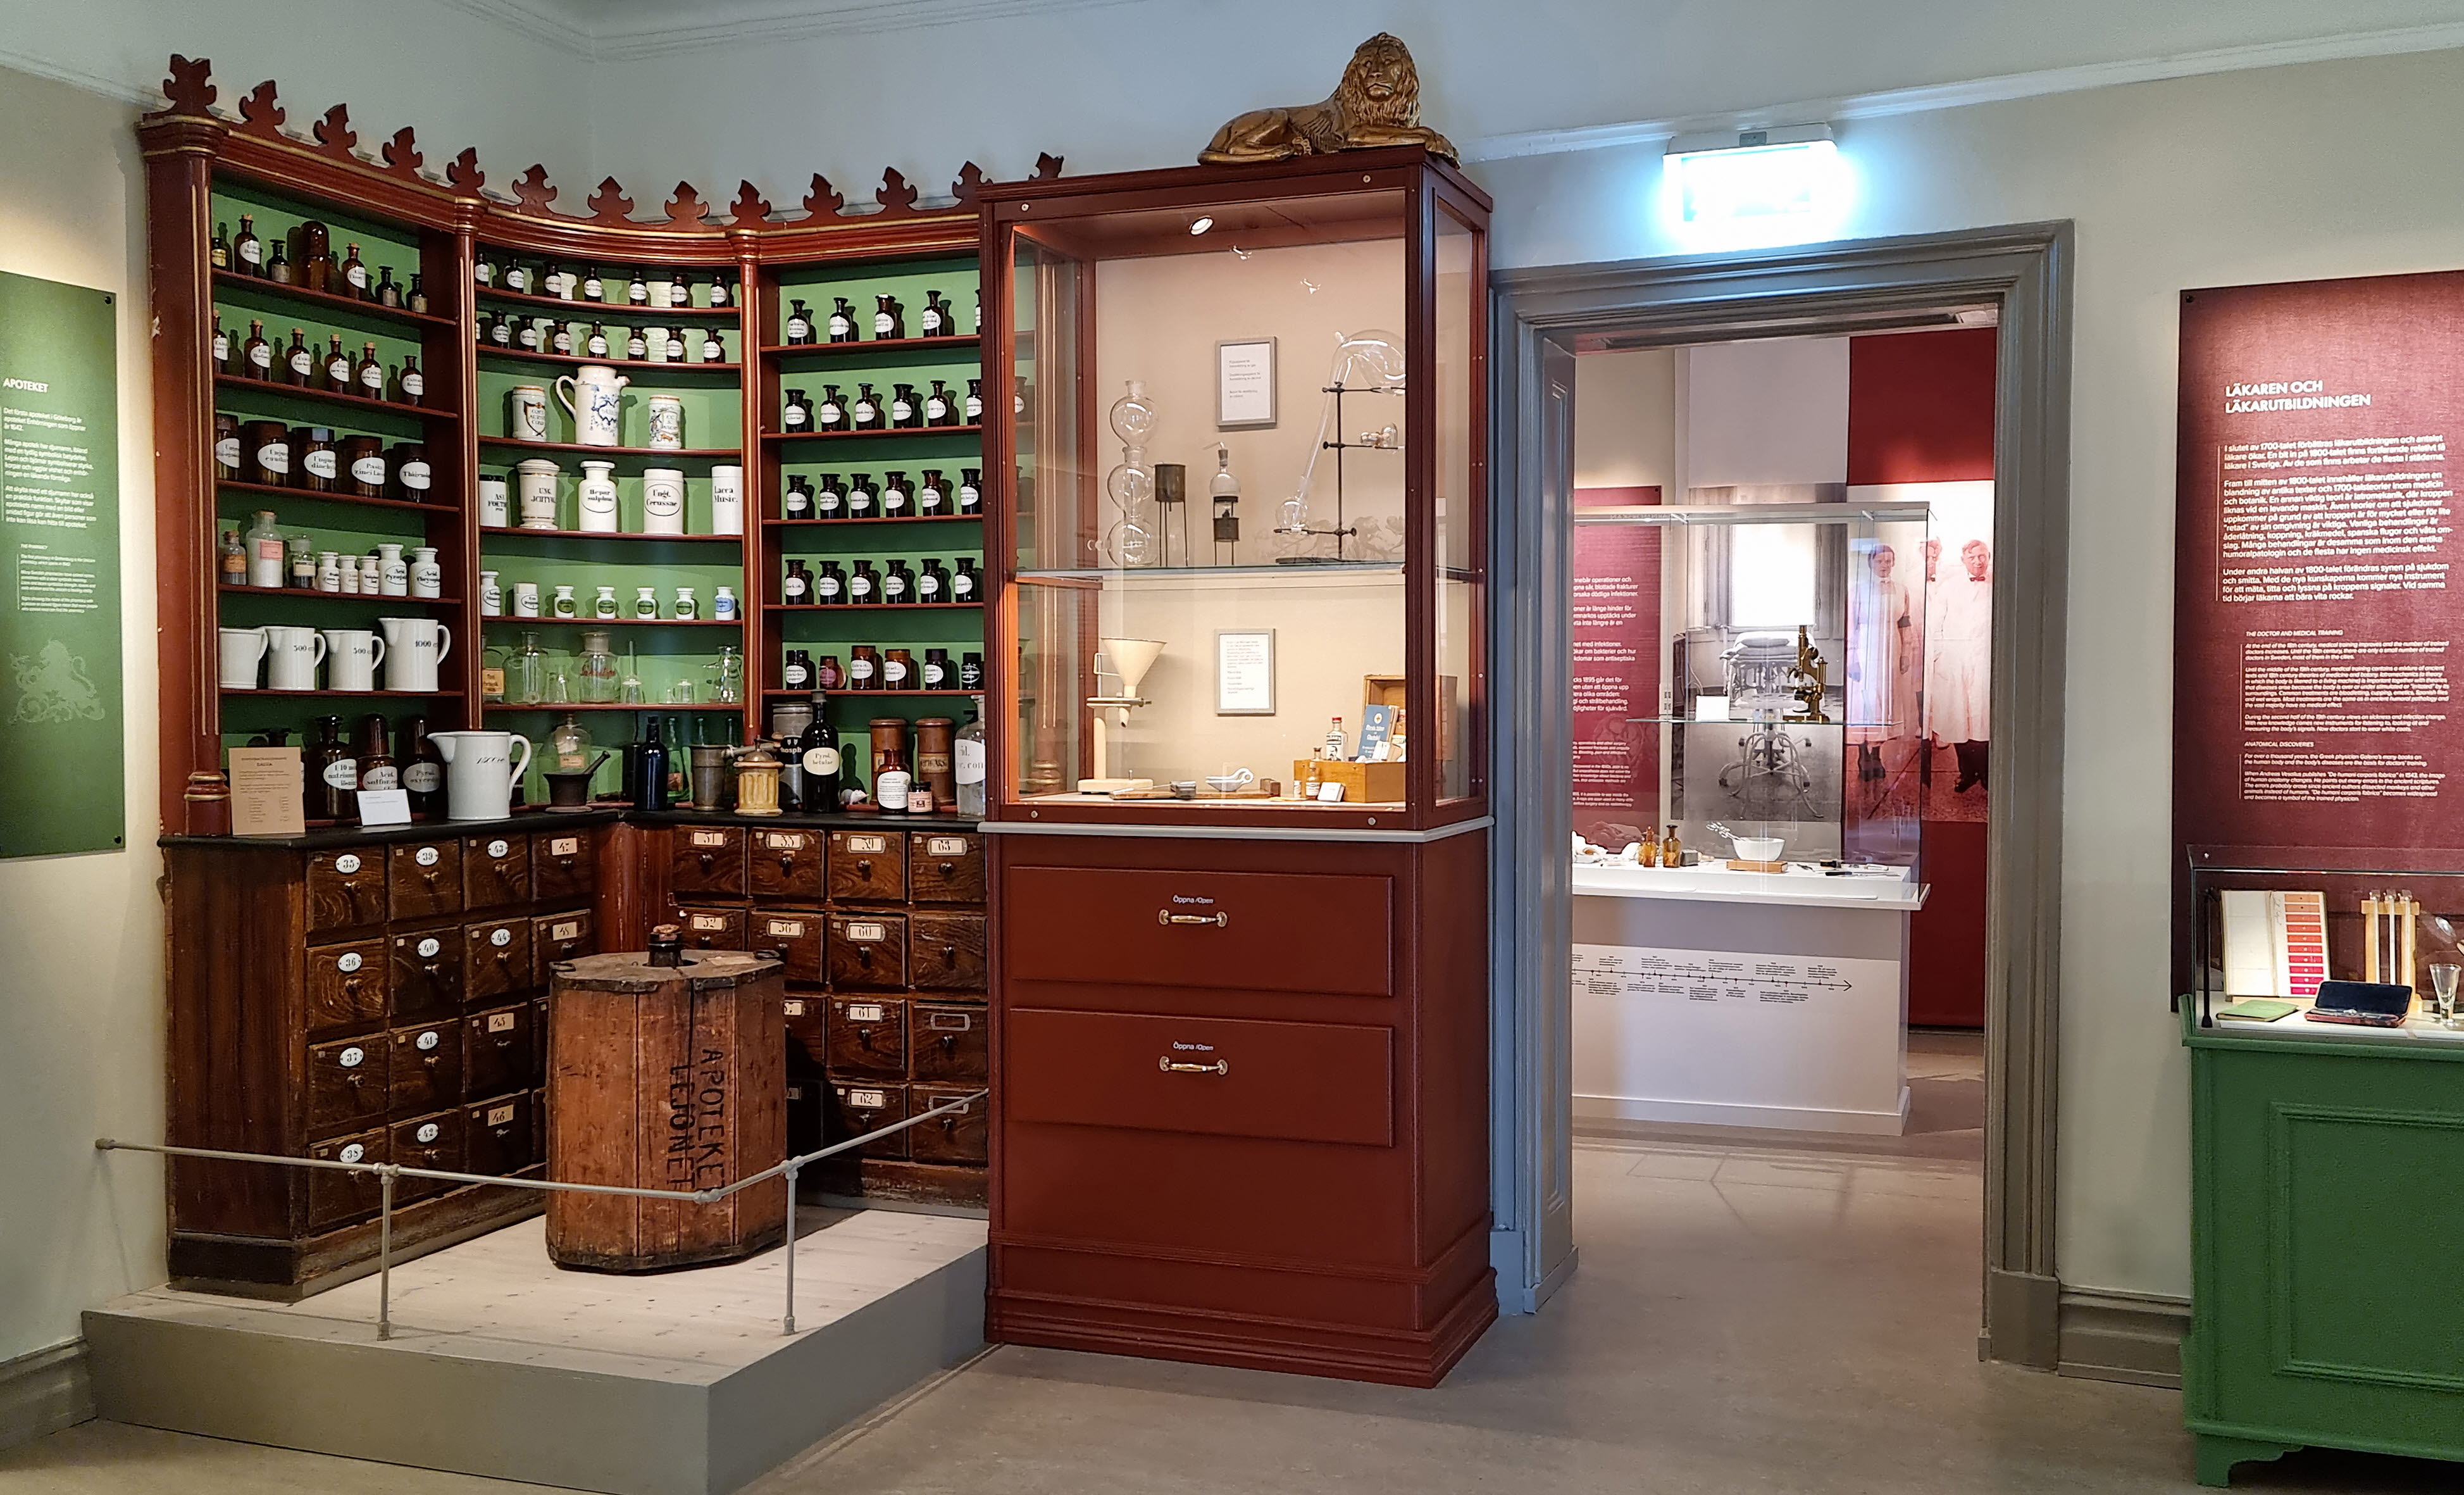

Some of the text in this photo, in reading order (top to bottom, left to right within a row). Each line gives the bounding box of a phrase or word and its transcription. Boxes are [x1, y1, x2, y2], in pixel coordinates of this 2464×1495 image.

[3, 377, 49, 392] APOTEKET
[2225, 380, 2323, 397] LÄKAREN OCH
[2225, 394, 2371, 413] LÄKARUTBILDNINGEN
[2241, 541, 2267, 549] Många
[2268, 540, 2317, 548] behandlingar
[2223, 549, 2286, 558] humoralpatologin
[2314, 547, 2335, 556] flesta
[2349, 547, 2372, 556] ingen
[2372, 546, 2411, 554] medicinsk
[2412, 544, 2437, 553] effekt.
[2305, 565, 2343, 573] 1800-talet
[2343, 565, 2380, 573] förändras
[2380, 565, 2404, 573] synen
[2405, 563, 2415, 572] på
[2416, 563, 2449, 572] sjukdom
[2292, 576, 2306, 584] nya
[2307, 575, 2355, 583] kunskaperna
[2298, 584, 2321, 593] lyssna
[2322, 583, 2332, 592] på
[2334, 584, 2369, 592] kroppens
[2370, 582, 2402, 591] signaler.
[2234, 594, 2255, 603] börjar
[2329, 592, 2354, 600] rockar.
[495, 845, 504, 853] 43
[423, 852, 433, 861] 39
[343, 860, 355, 869] 35
[1173, 894, 1194, 904] Öppna
[859, 927, 871, 937] 60
[497, 933, 506, 942] 44
[425, 943, 434, 953] 40
[345, 958, 356, 968] 36
[424, 1036, 433, 1045] 41
[1173, 1041, 1194, 1051] Öppna
[347, 1052, 357, 1063] 37
[697, 1049, 725, 1192] APOTEKET
[666, 1065, 696, 1189] LEJONET
[424, 1128, 433, 1138] 42
[347, 1149, 358, 1159] 38
